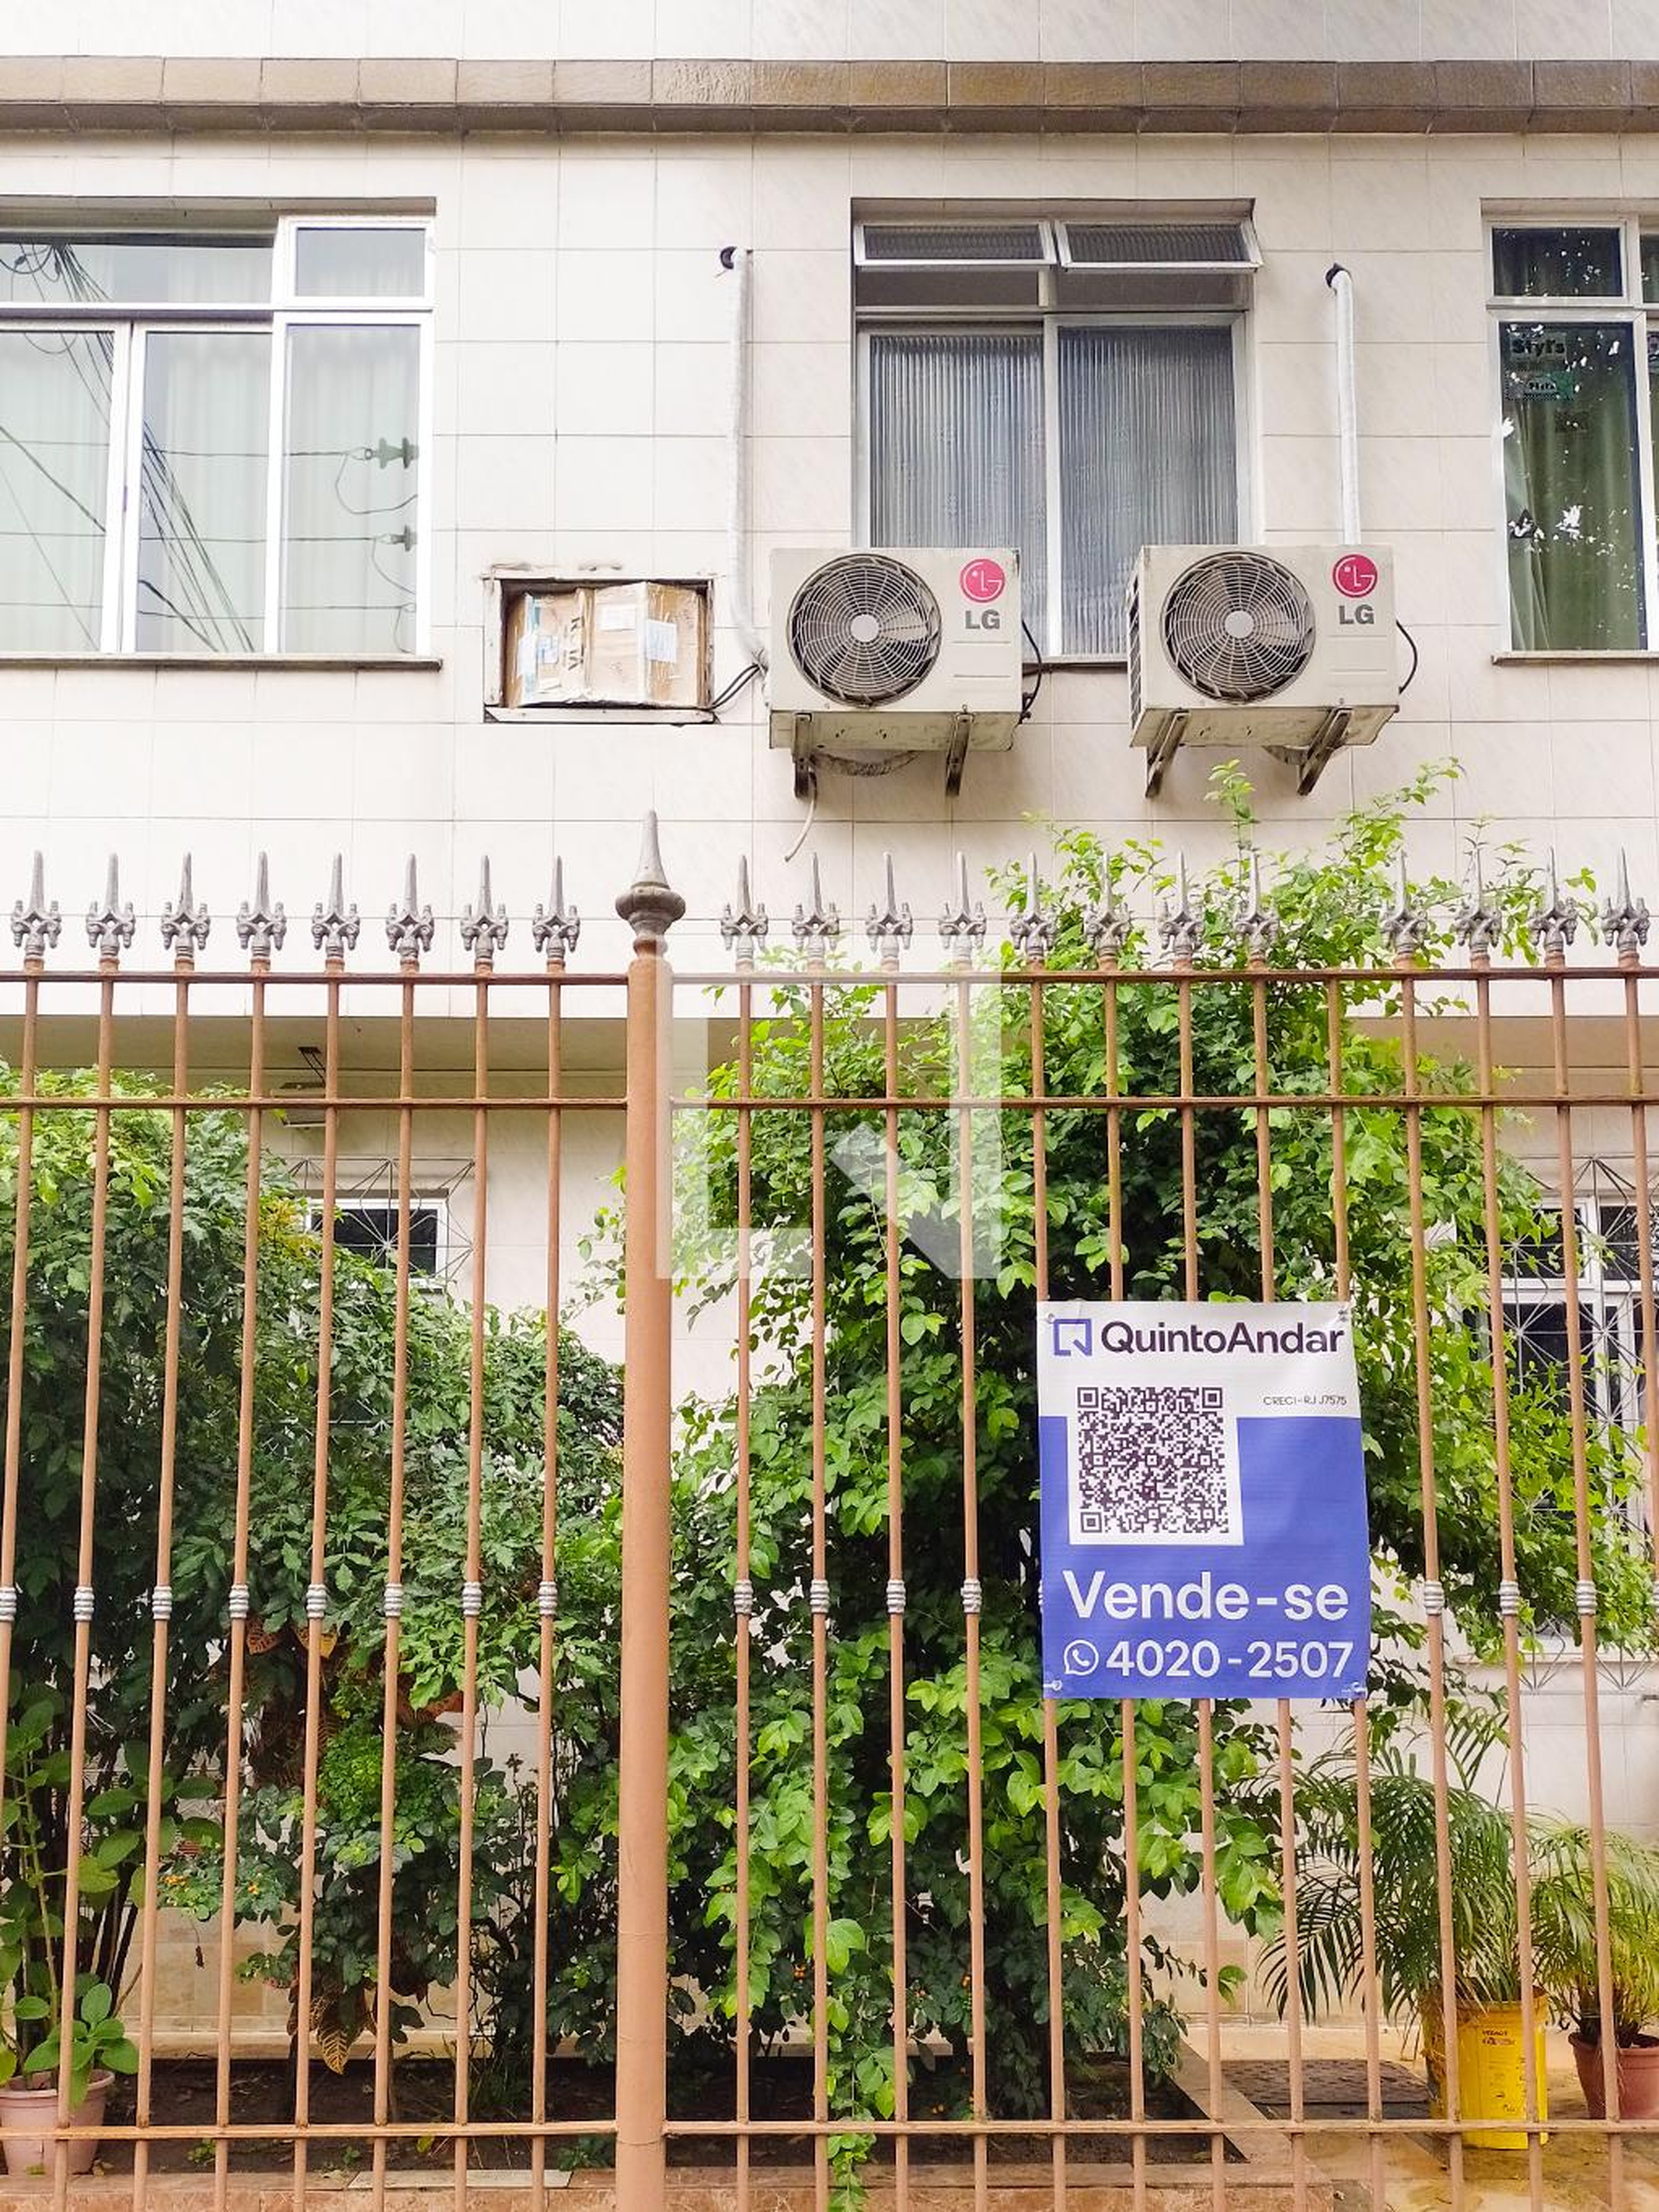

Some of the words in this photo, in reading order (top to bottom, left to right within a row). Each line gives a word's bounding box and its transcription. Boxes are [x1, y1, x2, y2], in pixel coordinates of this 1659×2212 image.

[965, 609, 1000, 630] LG
[1339, 605, 1375, 624] LG
[1101, 1321, 1344, 1354] QuintoAndar
[1062, 1570, 1349, 1620] Vende-se
[1106, 1641, 1354, 1678] 4020-2507
